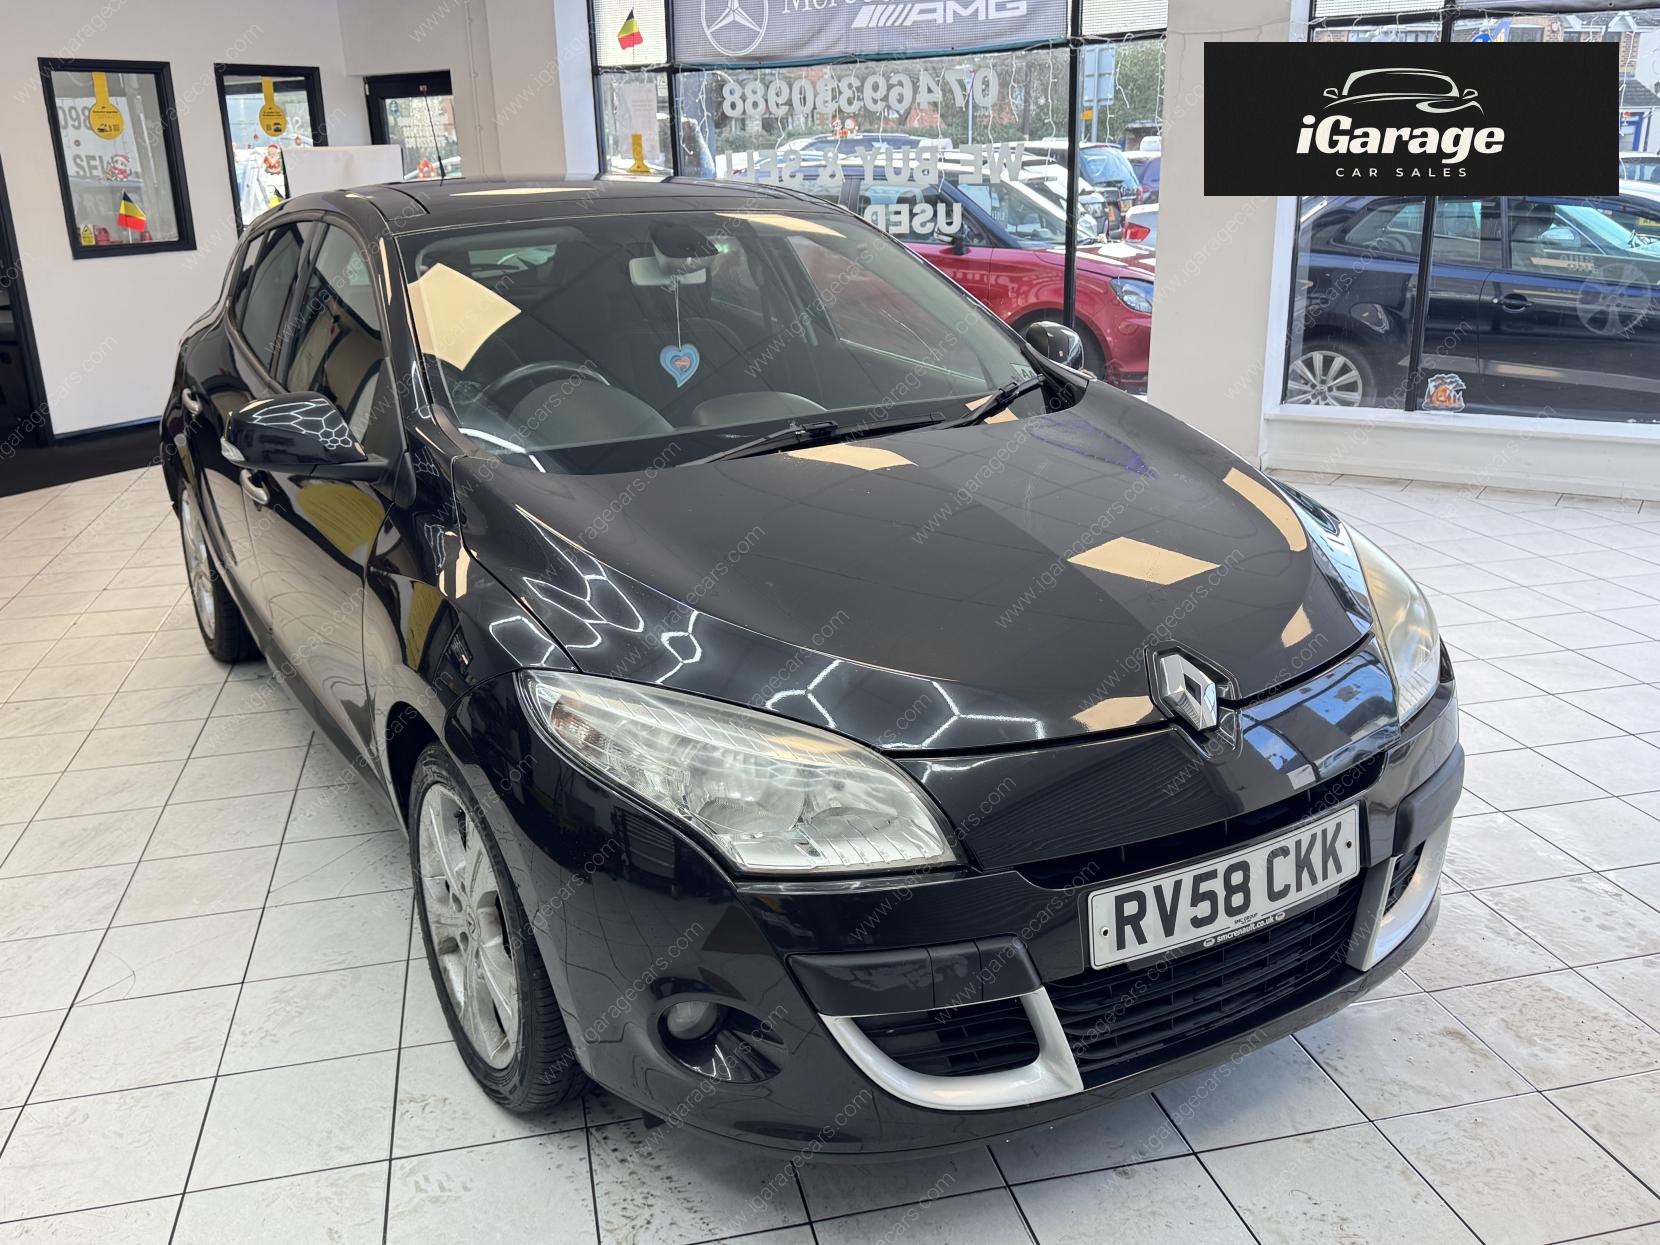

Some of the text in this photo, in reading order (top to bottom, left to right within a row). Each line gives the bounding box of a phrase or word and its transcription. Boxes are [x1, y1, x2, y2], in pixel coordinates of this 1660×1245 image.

[1114, 860, 1251, 951] RV58
[1266, 821, 1343, 902] CKK
[1217, 915, 1275, 942] smcrenault.co.uk
